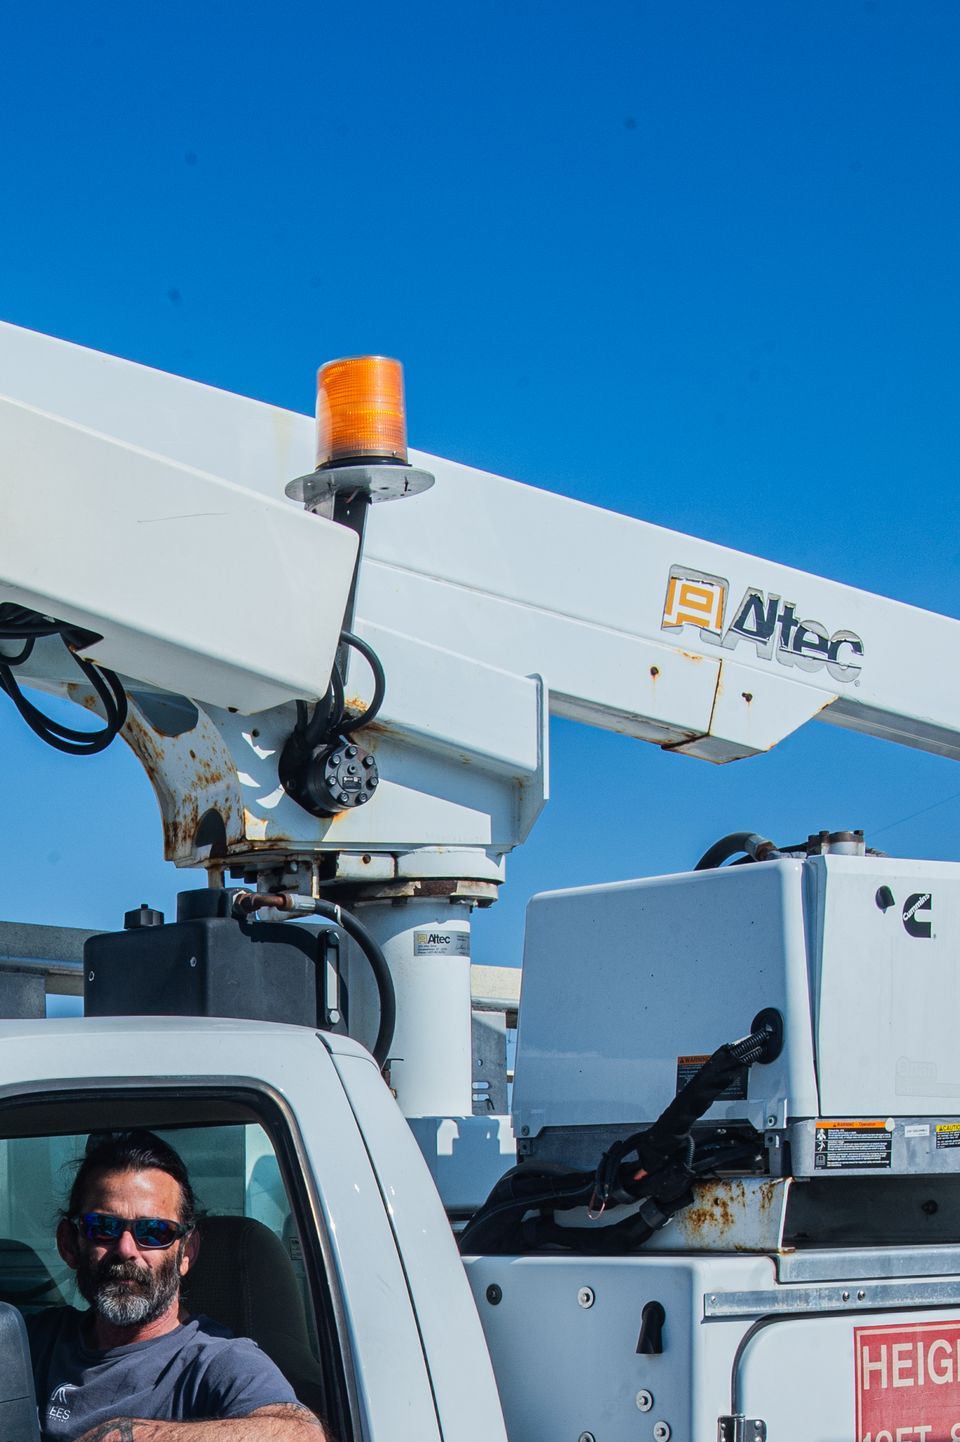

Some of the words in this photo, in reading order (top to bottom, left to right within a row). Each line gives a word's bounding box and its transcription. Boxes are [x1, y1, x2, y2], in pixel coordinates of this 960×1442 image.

[721, 586, 864, 683] Altec
[902, 894, 931, 921] Cummins
[427, 933, 451, 944] Altec
[862, 1338, 960, 1390] HEIG
[49, 1406, 71, 1420] EES
